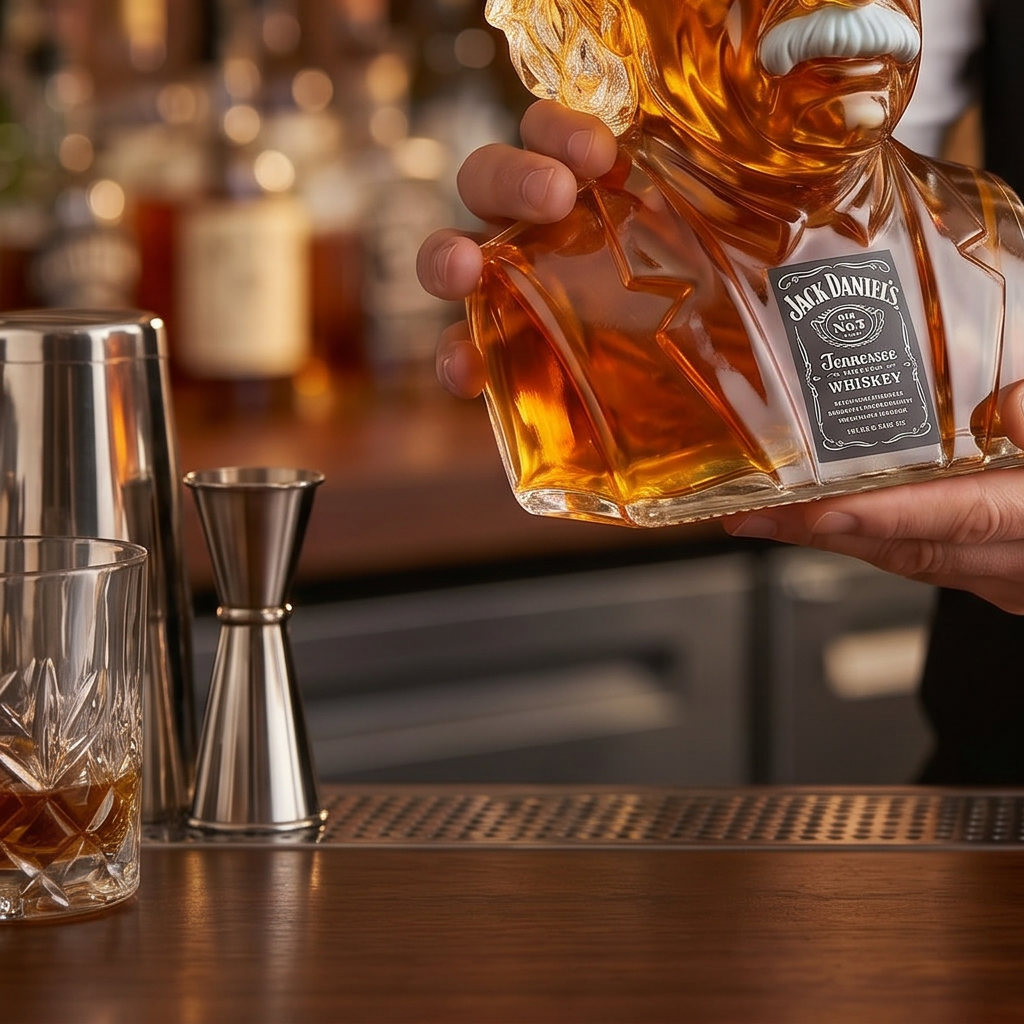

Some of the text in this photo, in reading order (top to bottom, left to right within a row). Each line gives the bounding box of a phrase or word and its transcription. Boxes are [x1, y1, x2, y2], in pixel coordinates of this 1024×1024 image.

[784, 273, 899, 322] JACK DANIEL'S
[828, 371, 901, 394] WHISKEY
